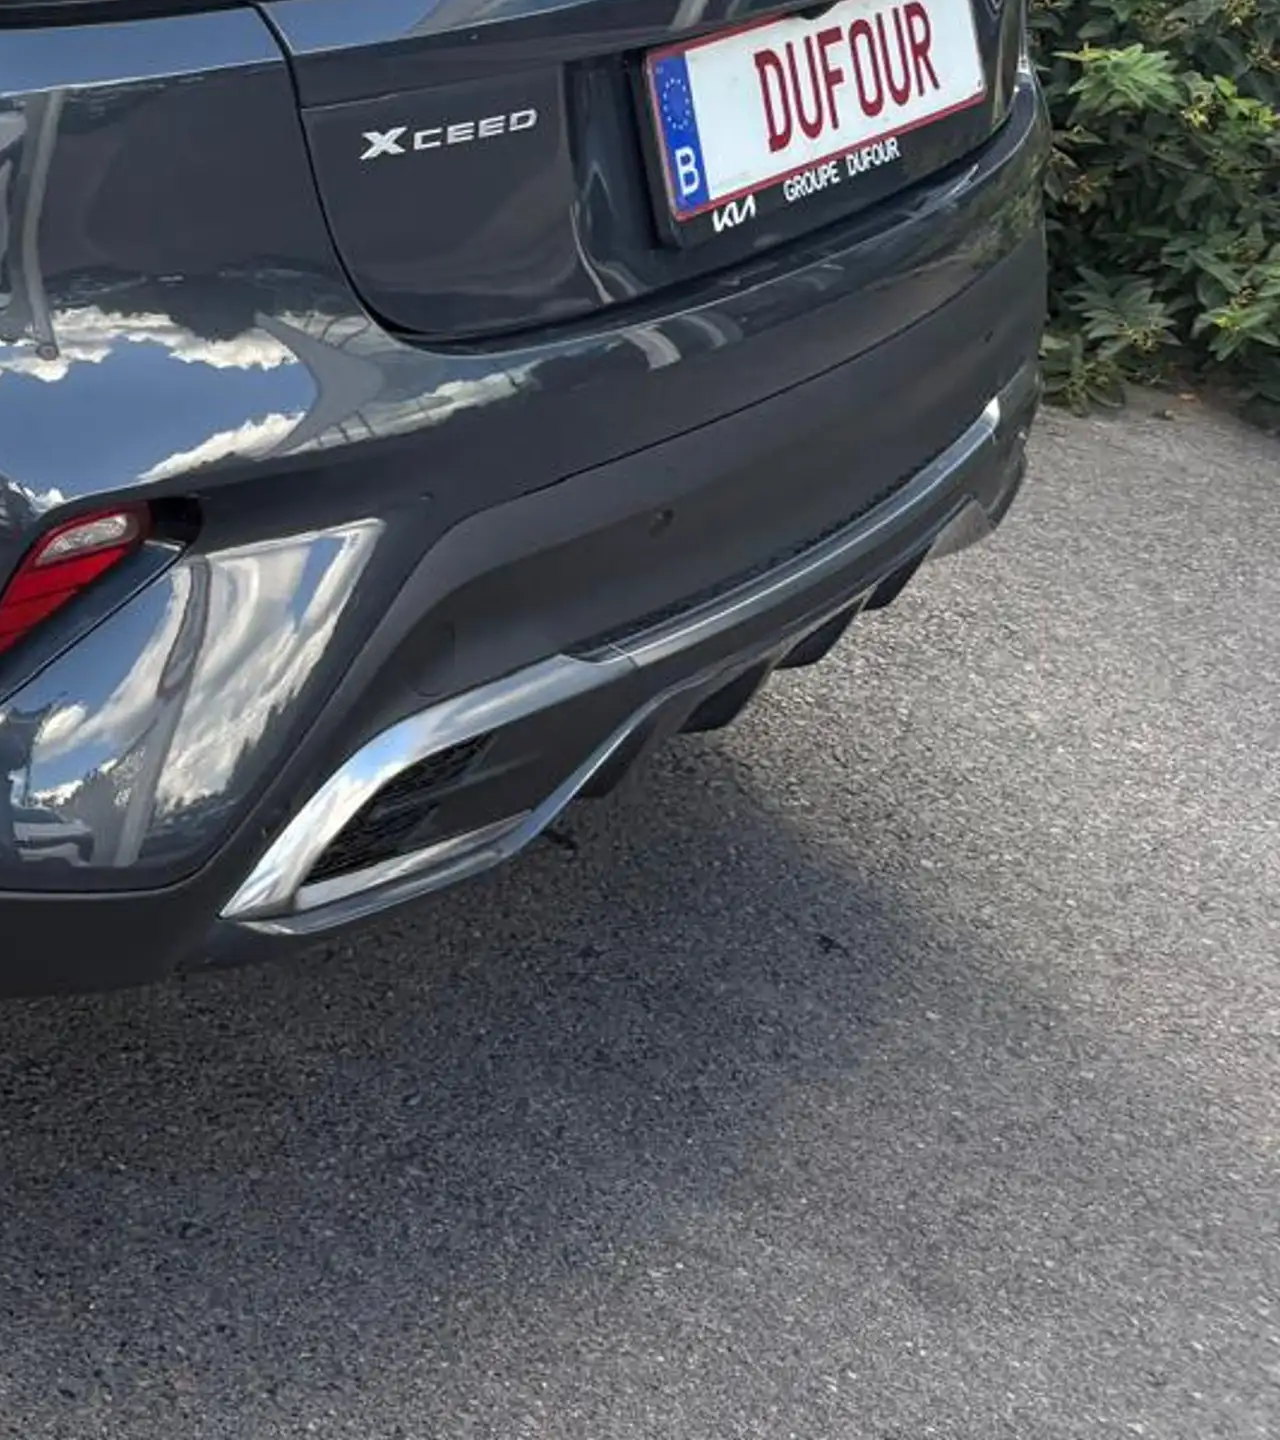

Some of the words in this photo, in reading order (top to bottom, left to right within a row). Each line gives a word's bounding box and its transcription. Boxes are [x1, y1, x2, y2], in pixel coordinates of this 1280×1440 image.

[753, 1, 941, 154] DUFOUR
[675, 147, 700, 196] B
[782, 161, 841, 203] GROUPE
[846, 137, 902, 177] DUFOUR
